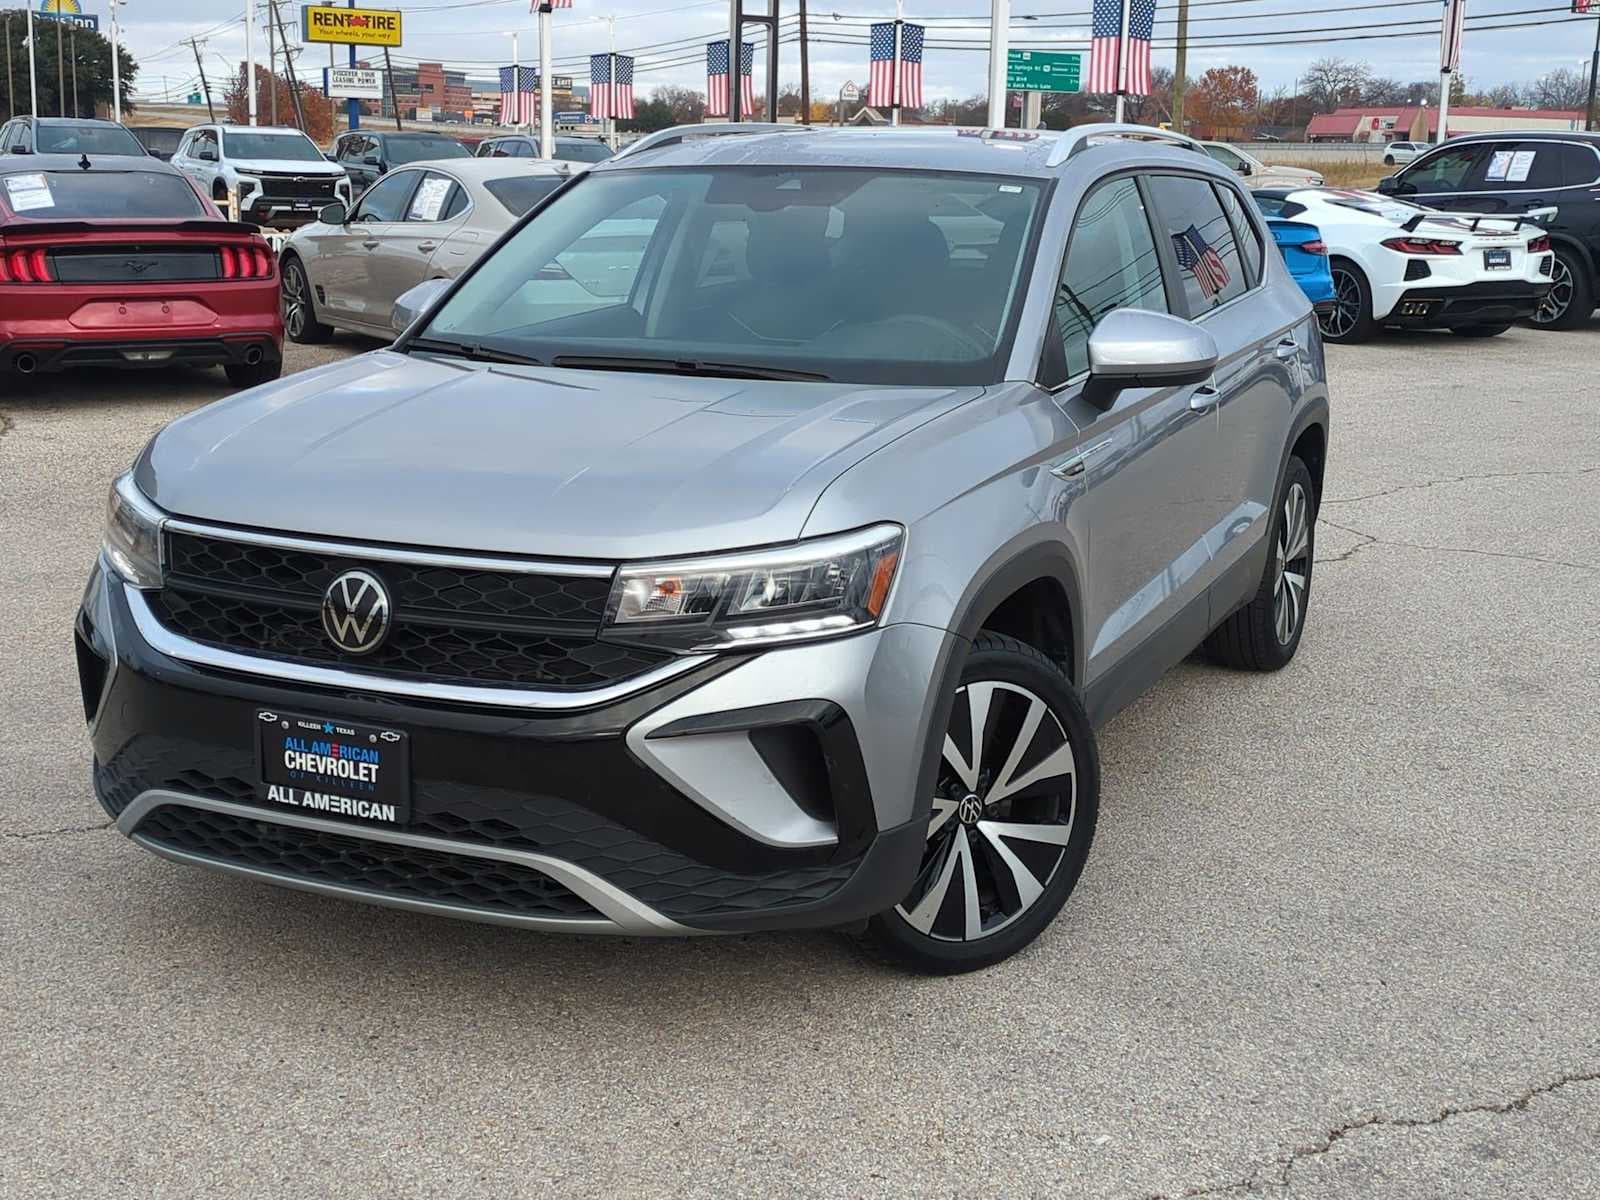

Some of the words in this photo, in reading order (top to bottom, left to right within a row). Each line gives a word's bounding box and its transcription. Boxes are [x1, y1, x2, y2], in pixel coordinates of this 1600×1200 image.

[313, 12, 353, 28] RENT
[362, 15, 396, 31] TIRE
[335, 726, 355, 736] TEXAS
[285, 737, 308, 752] ALL
[311, 741, 379, 764] AMERICAN
[284, 750, 379, 783] CHEVROLET
[267, 785, 299, 806] ALL
[302, 791, 396, 822] AMERICAN
